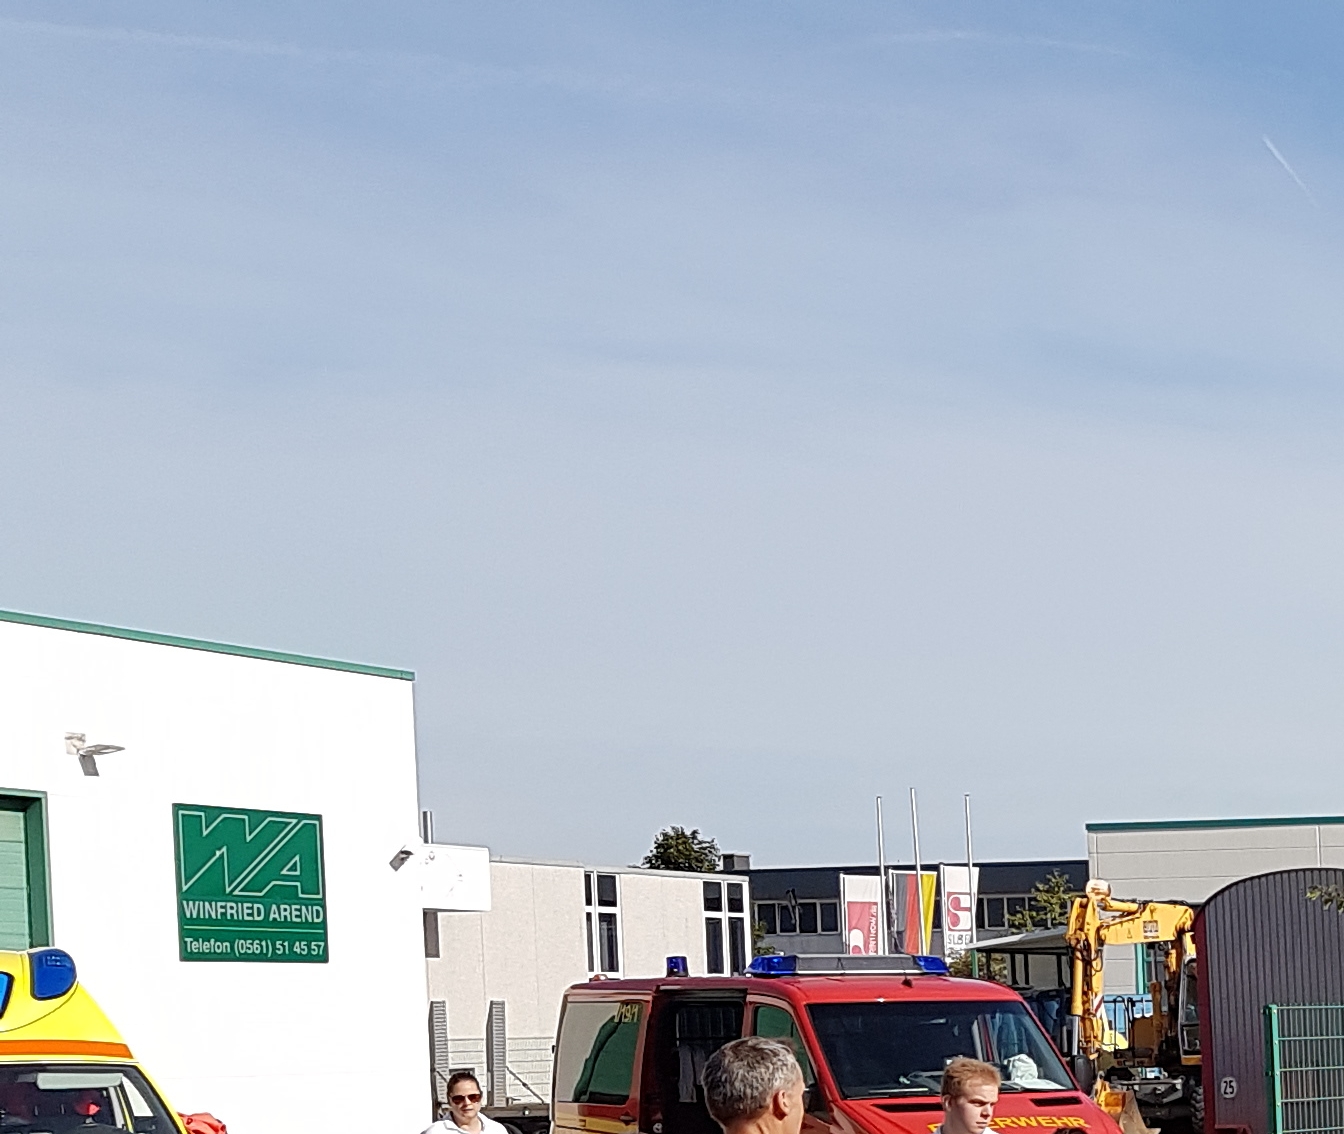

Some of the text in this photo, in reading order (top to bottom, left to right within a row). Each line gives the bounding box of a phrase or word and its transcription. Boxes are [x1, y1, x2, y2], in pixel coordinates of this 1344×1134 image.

[178, 810, 323, 898] WA
[182, 900, 324, 922] WINFRIED AREND
[184, 938, 325, 957] Telefon (0561) 51 45 57
[1223, 1080, 1235, 1095] 25
[927, 1116, 1091, 1133] FERWEHR
